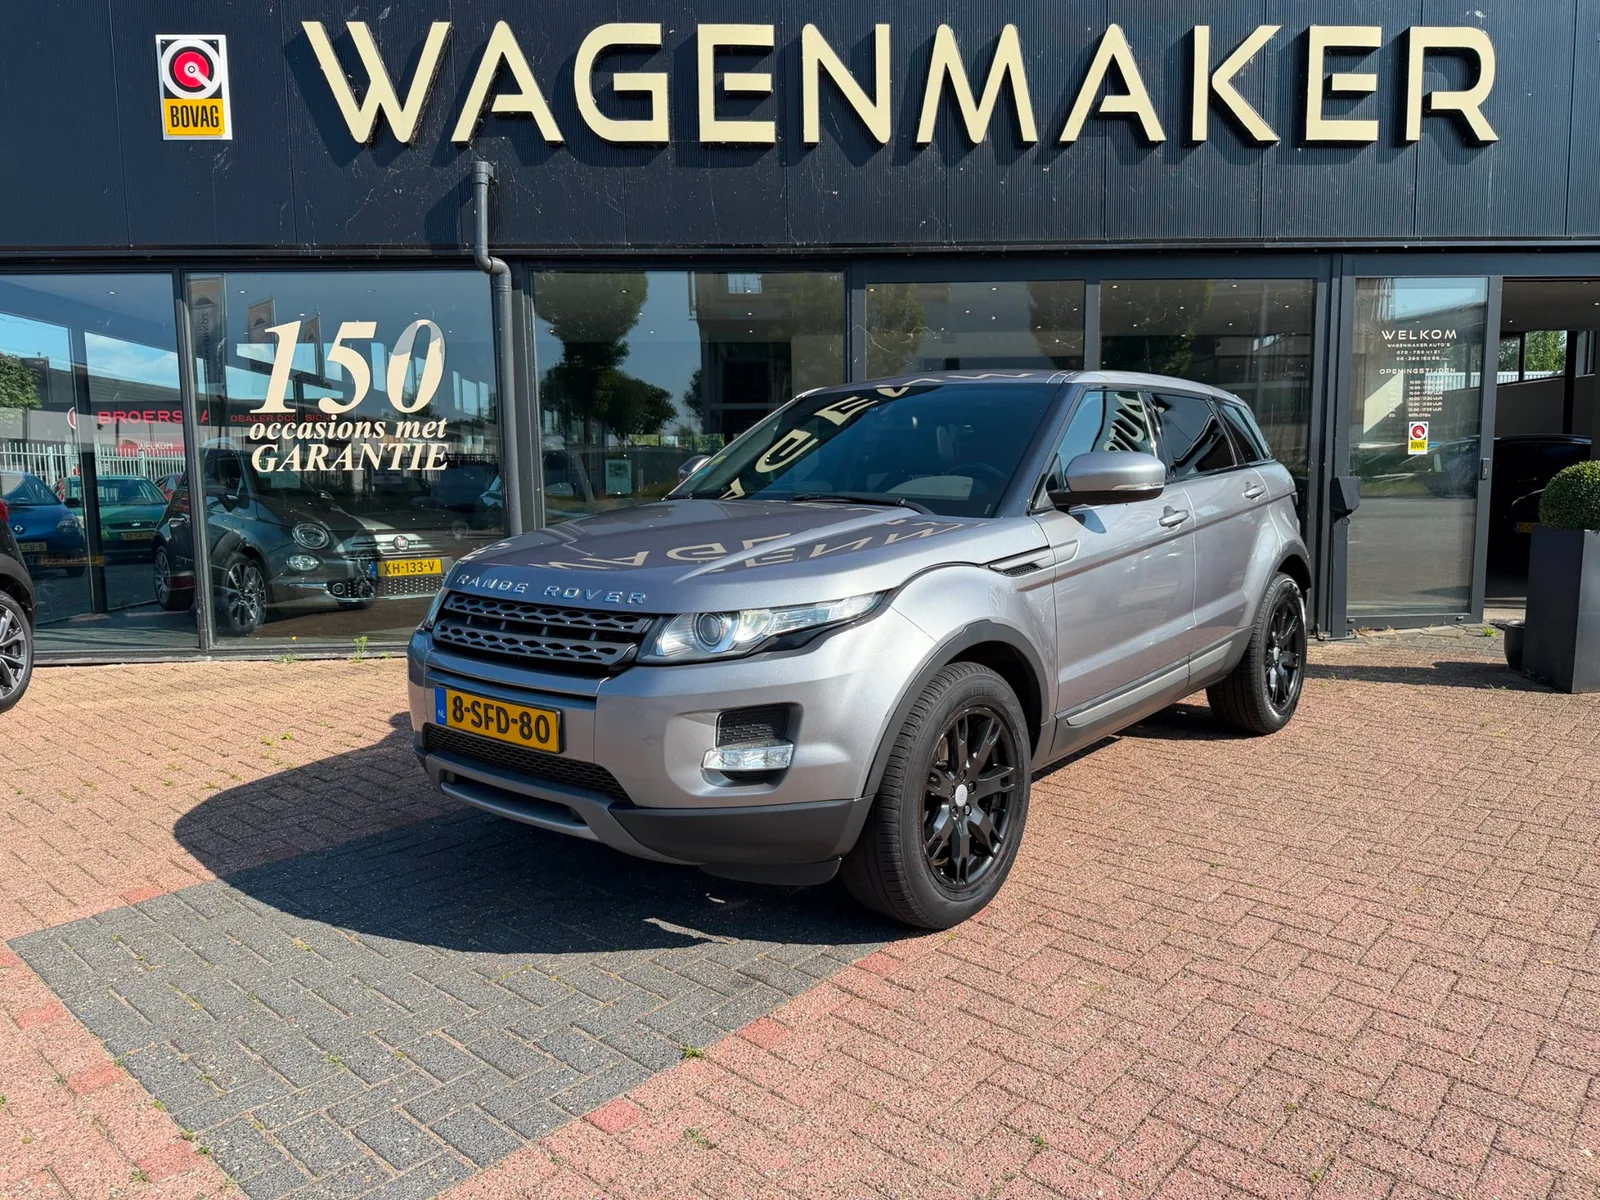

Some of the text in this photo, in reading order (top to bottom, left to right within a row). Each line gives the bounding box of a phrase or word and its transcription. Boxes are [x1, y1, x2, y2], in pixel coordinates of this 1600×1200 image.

[301, 20, 1499, 144] WAGENMAKER
[169, 103, 220, 130] BOVAG
[1381, 329, 1457, 340] WELKOM
[249, 319, 446, 415] 150
[1380, 367, 1456, 375] OPENINGSTIJDEN
[230, 414, 273, 422] DEALER
[249, 414, 447, 440] occasions met
[251, 443, 449, 473] GARANTIE
[384, 561, 435, 574] XH-133-V
[455, 573, 647, 606] RANGE ROVER
[437, 707, 446, 719] NL
[450, 695, 550, 745] 8-SFD-80
